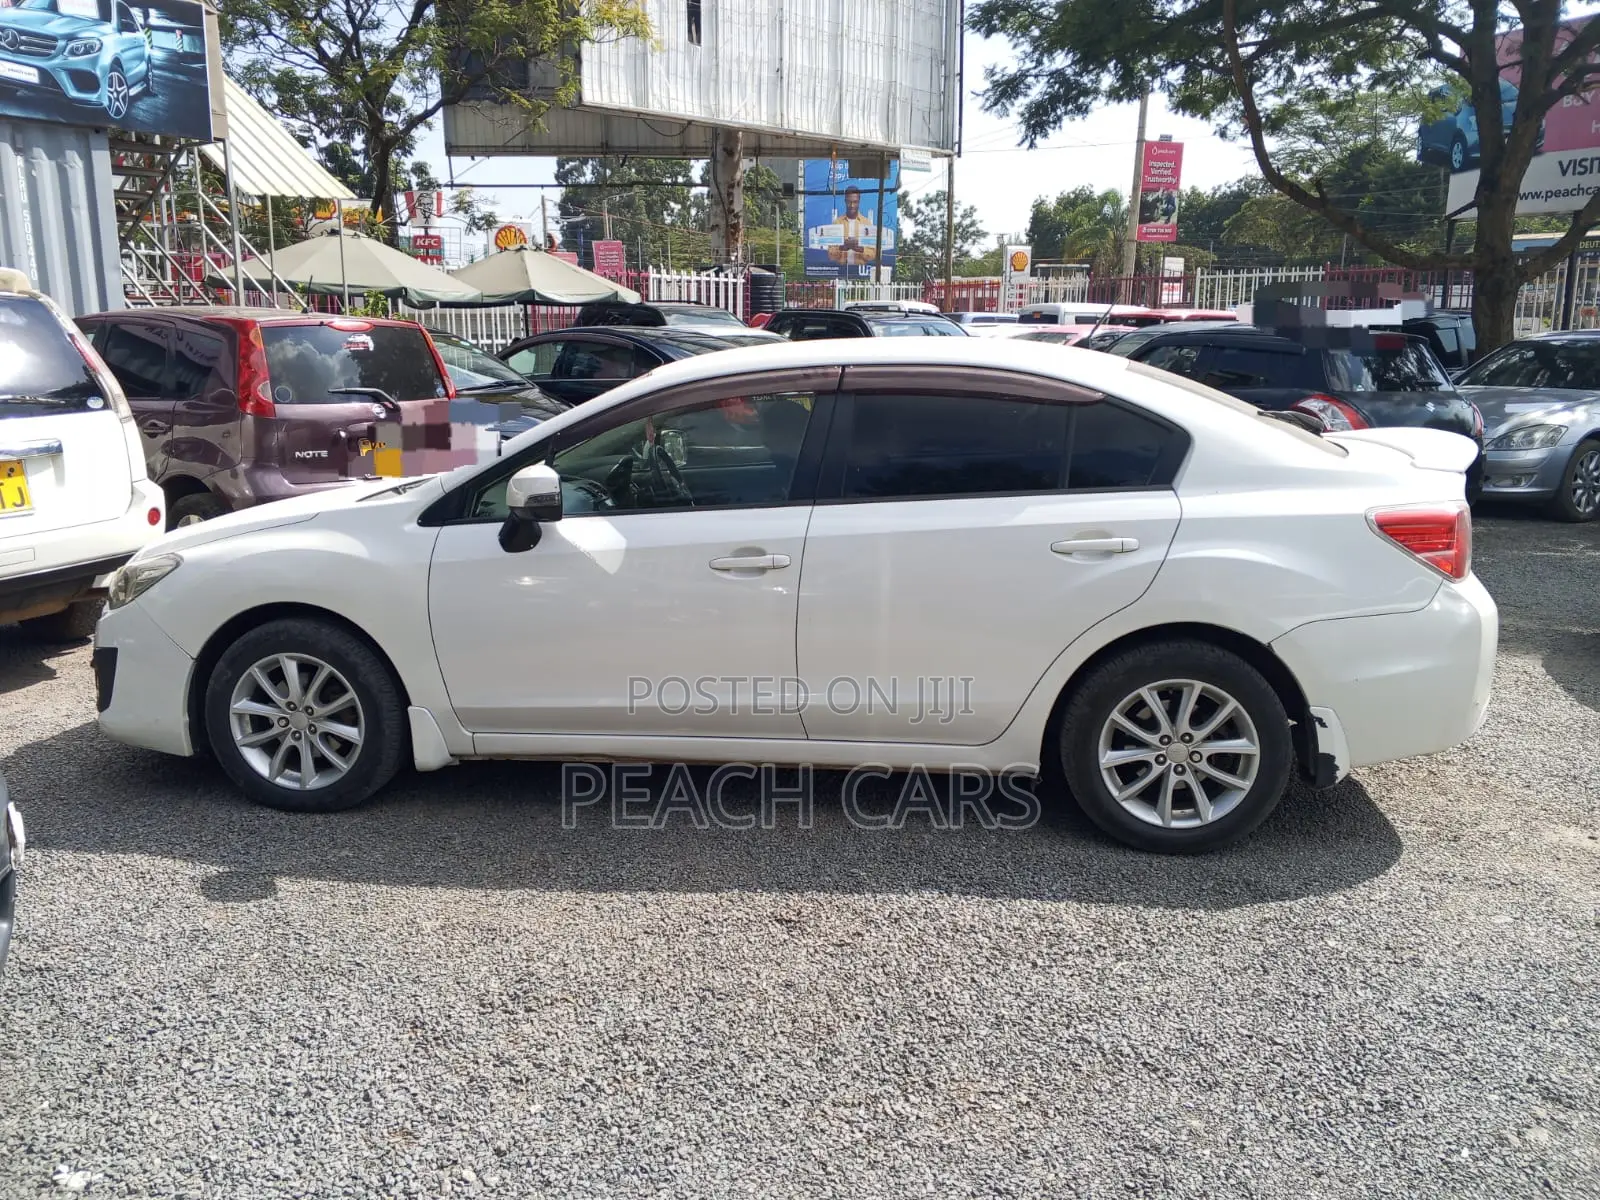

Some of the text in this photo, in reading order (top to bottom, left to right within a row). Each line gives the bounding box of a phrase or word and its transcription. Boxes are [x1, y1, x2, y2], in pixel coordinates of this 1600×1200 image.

[1518, 184, 1600, 202] ww.peachca
[415, 238, 439, 246] KFC
[295, 450, 328, 459] NOTE
